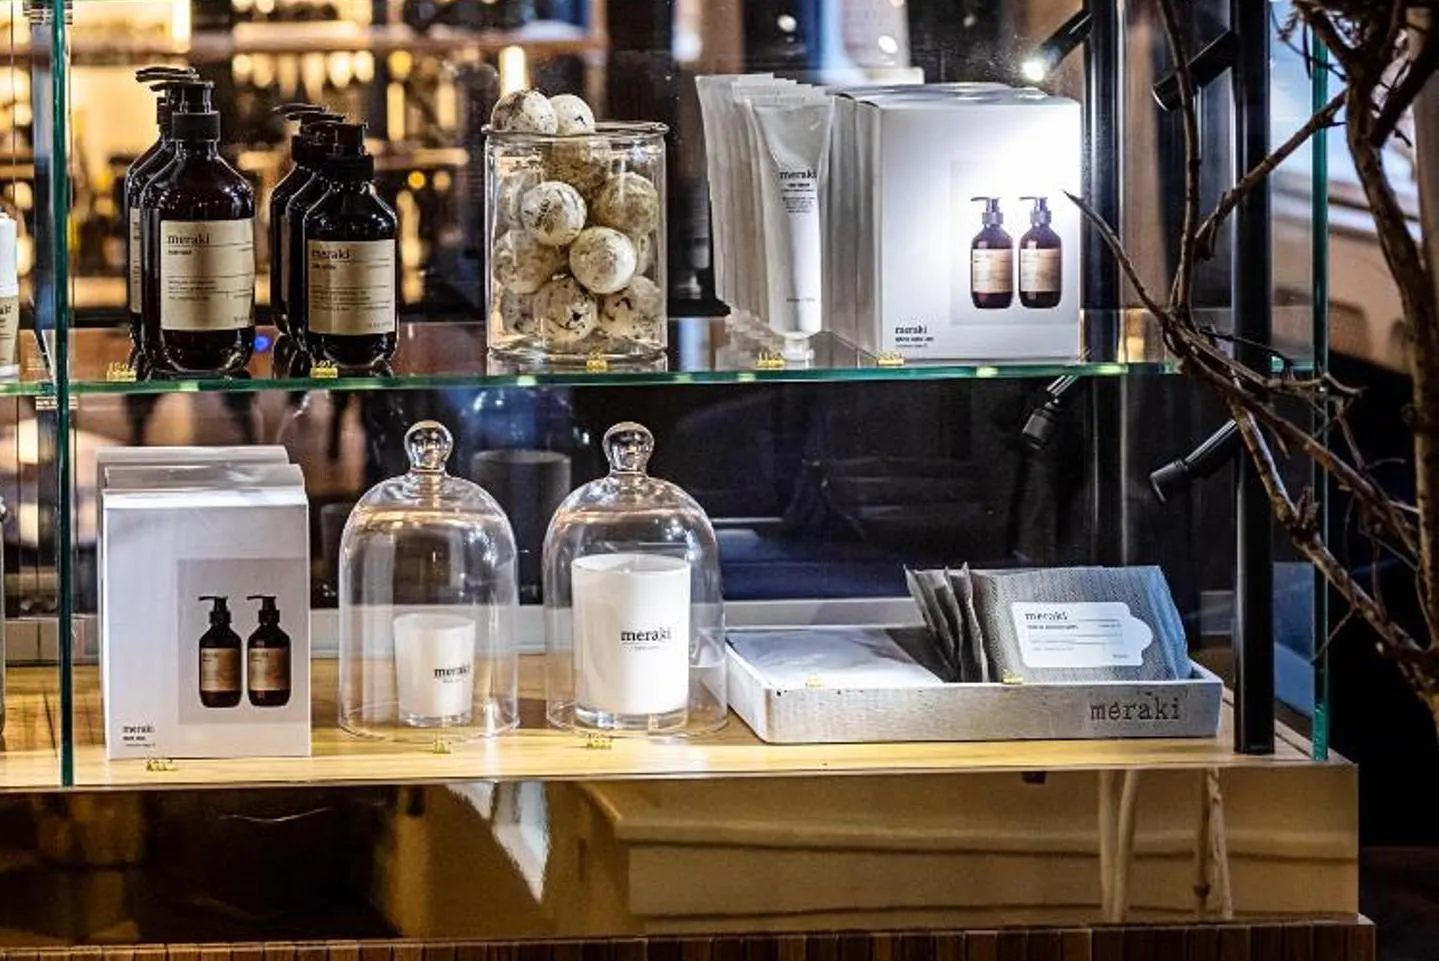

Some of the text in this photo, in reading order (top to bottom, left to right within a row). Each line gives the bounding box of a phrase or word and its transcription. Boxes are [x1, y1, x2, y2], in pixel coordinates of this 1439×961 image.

[779, 169, 818, 180] meraki
[167, 231, 210, 244] meraki
[312, 247, 350, 259] meraki
[1024, 610, 1069, 622] meraki
[620, 626, 673, 642] meraki
[1089, 696, 1182, 721] meraki
